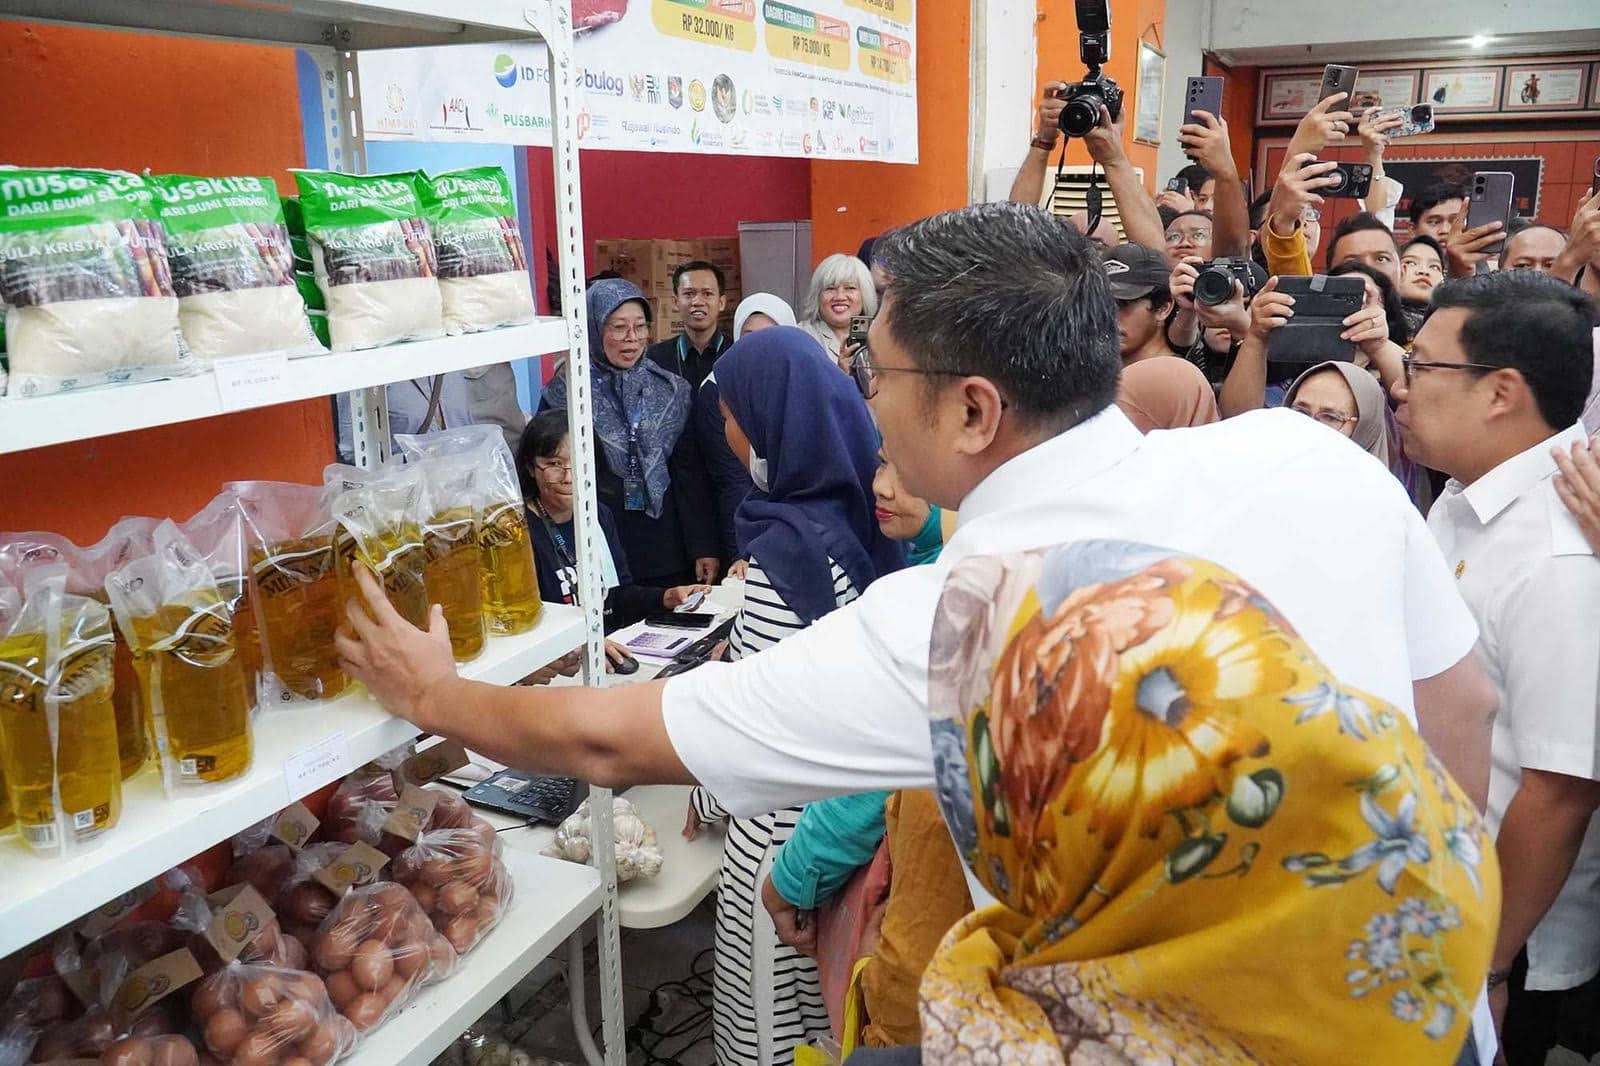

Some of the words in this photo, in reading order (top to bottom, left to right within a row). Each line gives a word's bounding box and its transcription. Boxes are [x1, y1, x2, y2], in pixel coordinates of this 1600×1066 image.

[682, 13, 692, 31] RP
[694, 17, 722, 37] 32.000/
[521, 66, 534, 81] ID
[584, 68, 624, 97] bulog
[7, 201, 49, 217] DARI
[52, 194, 95, 210] BUMI
[160, 206, 186, 218] ARI
[187, 199, 222, 213] BUMI
[329, 199, 359, 212] DARI
[168, 247, 195, 259] ULA
